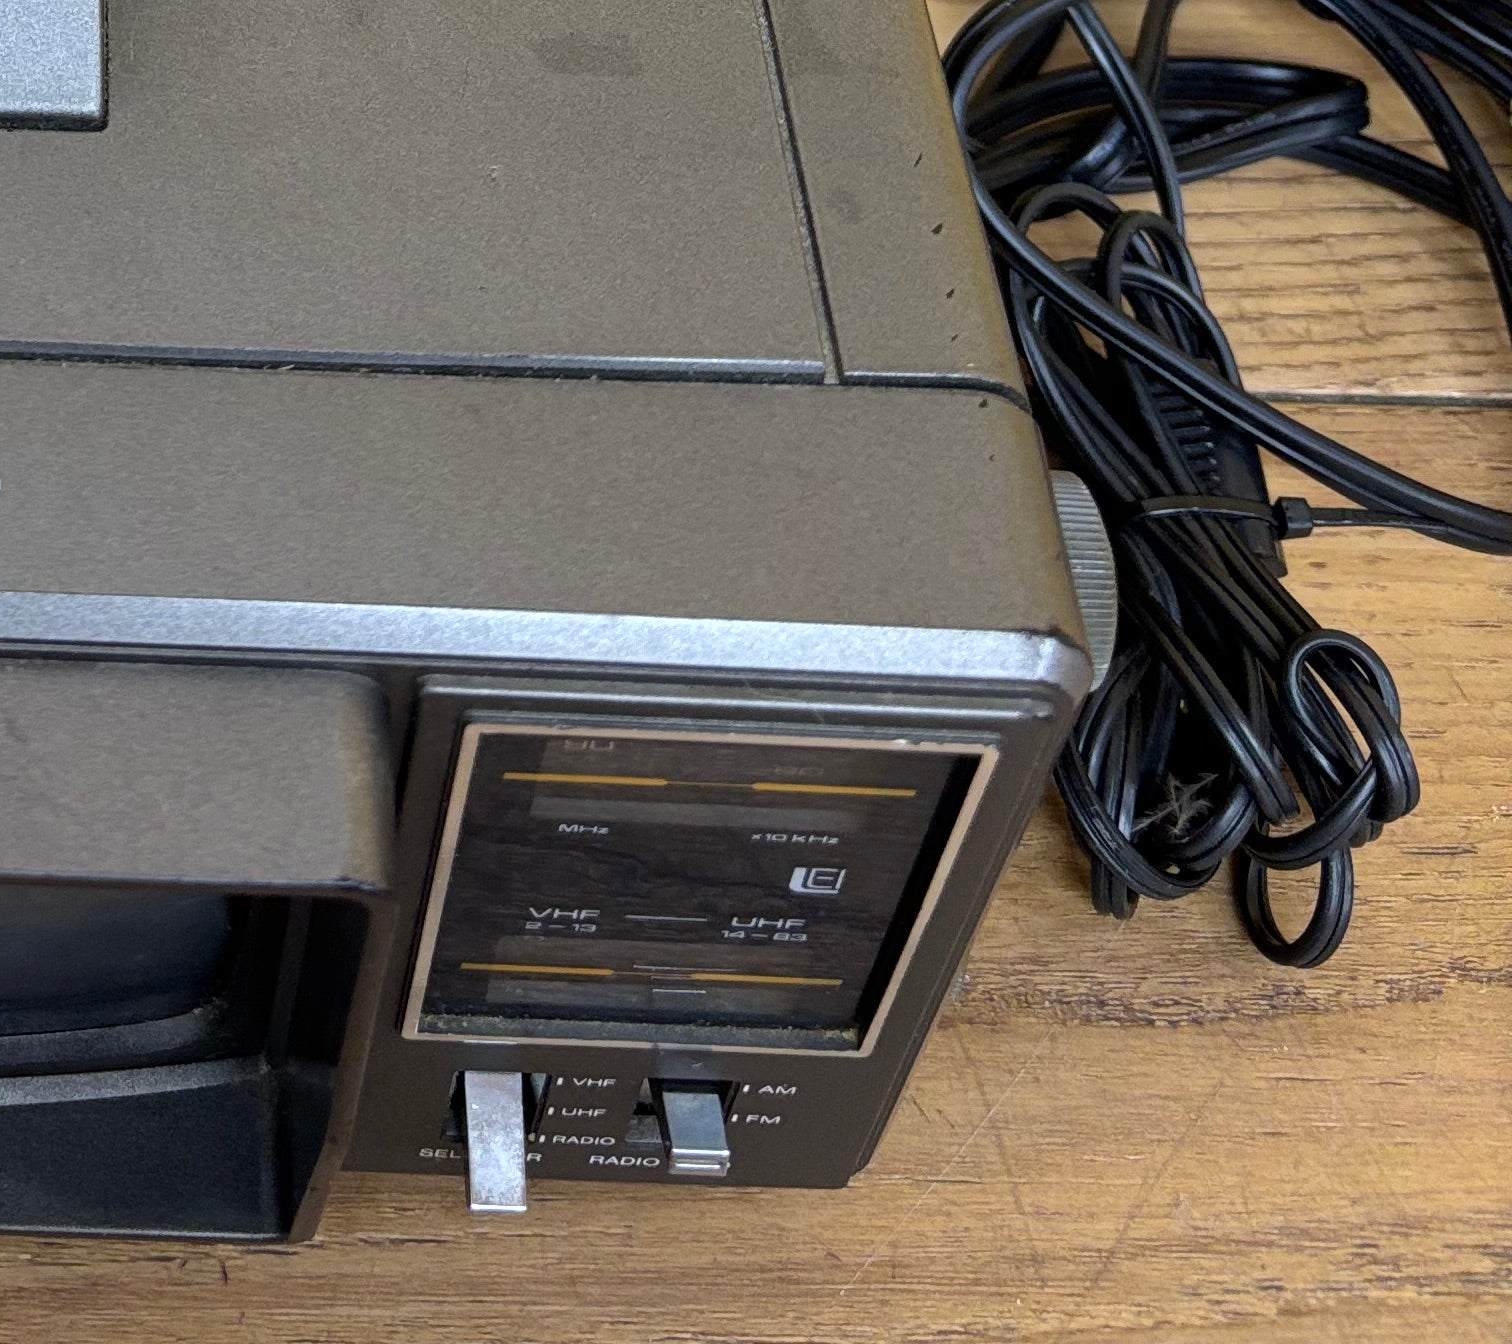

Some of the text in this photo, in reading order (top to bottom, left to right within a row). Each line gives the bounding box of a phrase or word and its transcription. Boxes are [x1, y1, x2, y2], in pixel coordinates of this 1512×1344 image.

[558, 823, 609, 834] MHz
[529, 907, 601, 920] VHF
[731, 916, 807, 929] UHF
[572, 1077, 617, 1088] VHF
[758, 1084, 797, 1096] AM
[561, 1107, 607, 1118] UHF
[746, 1114, 781, 1125] FM
[552, 1135, 616, 1146] RADIO
[589, 1155, 661, 1167] RADIO
